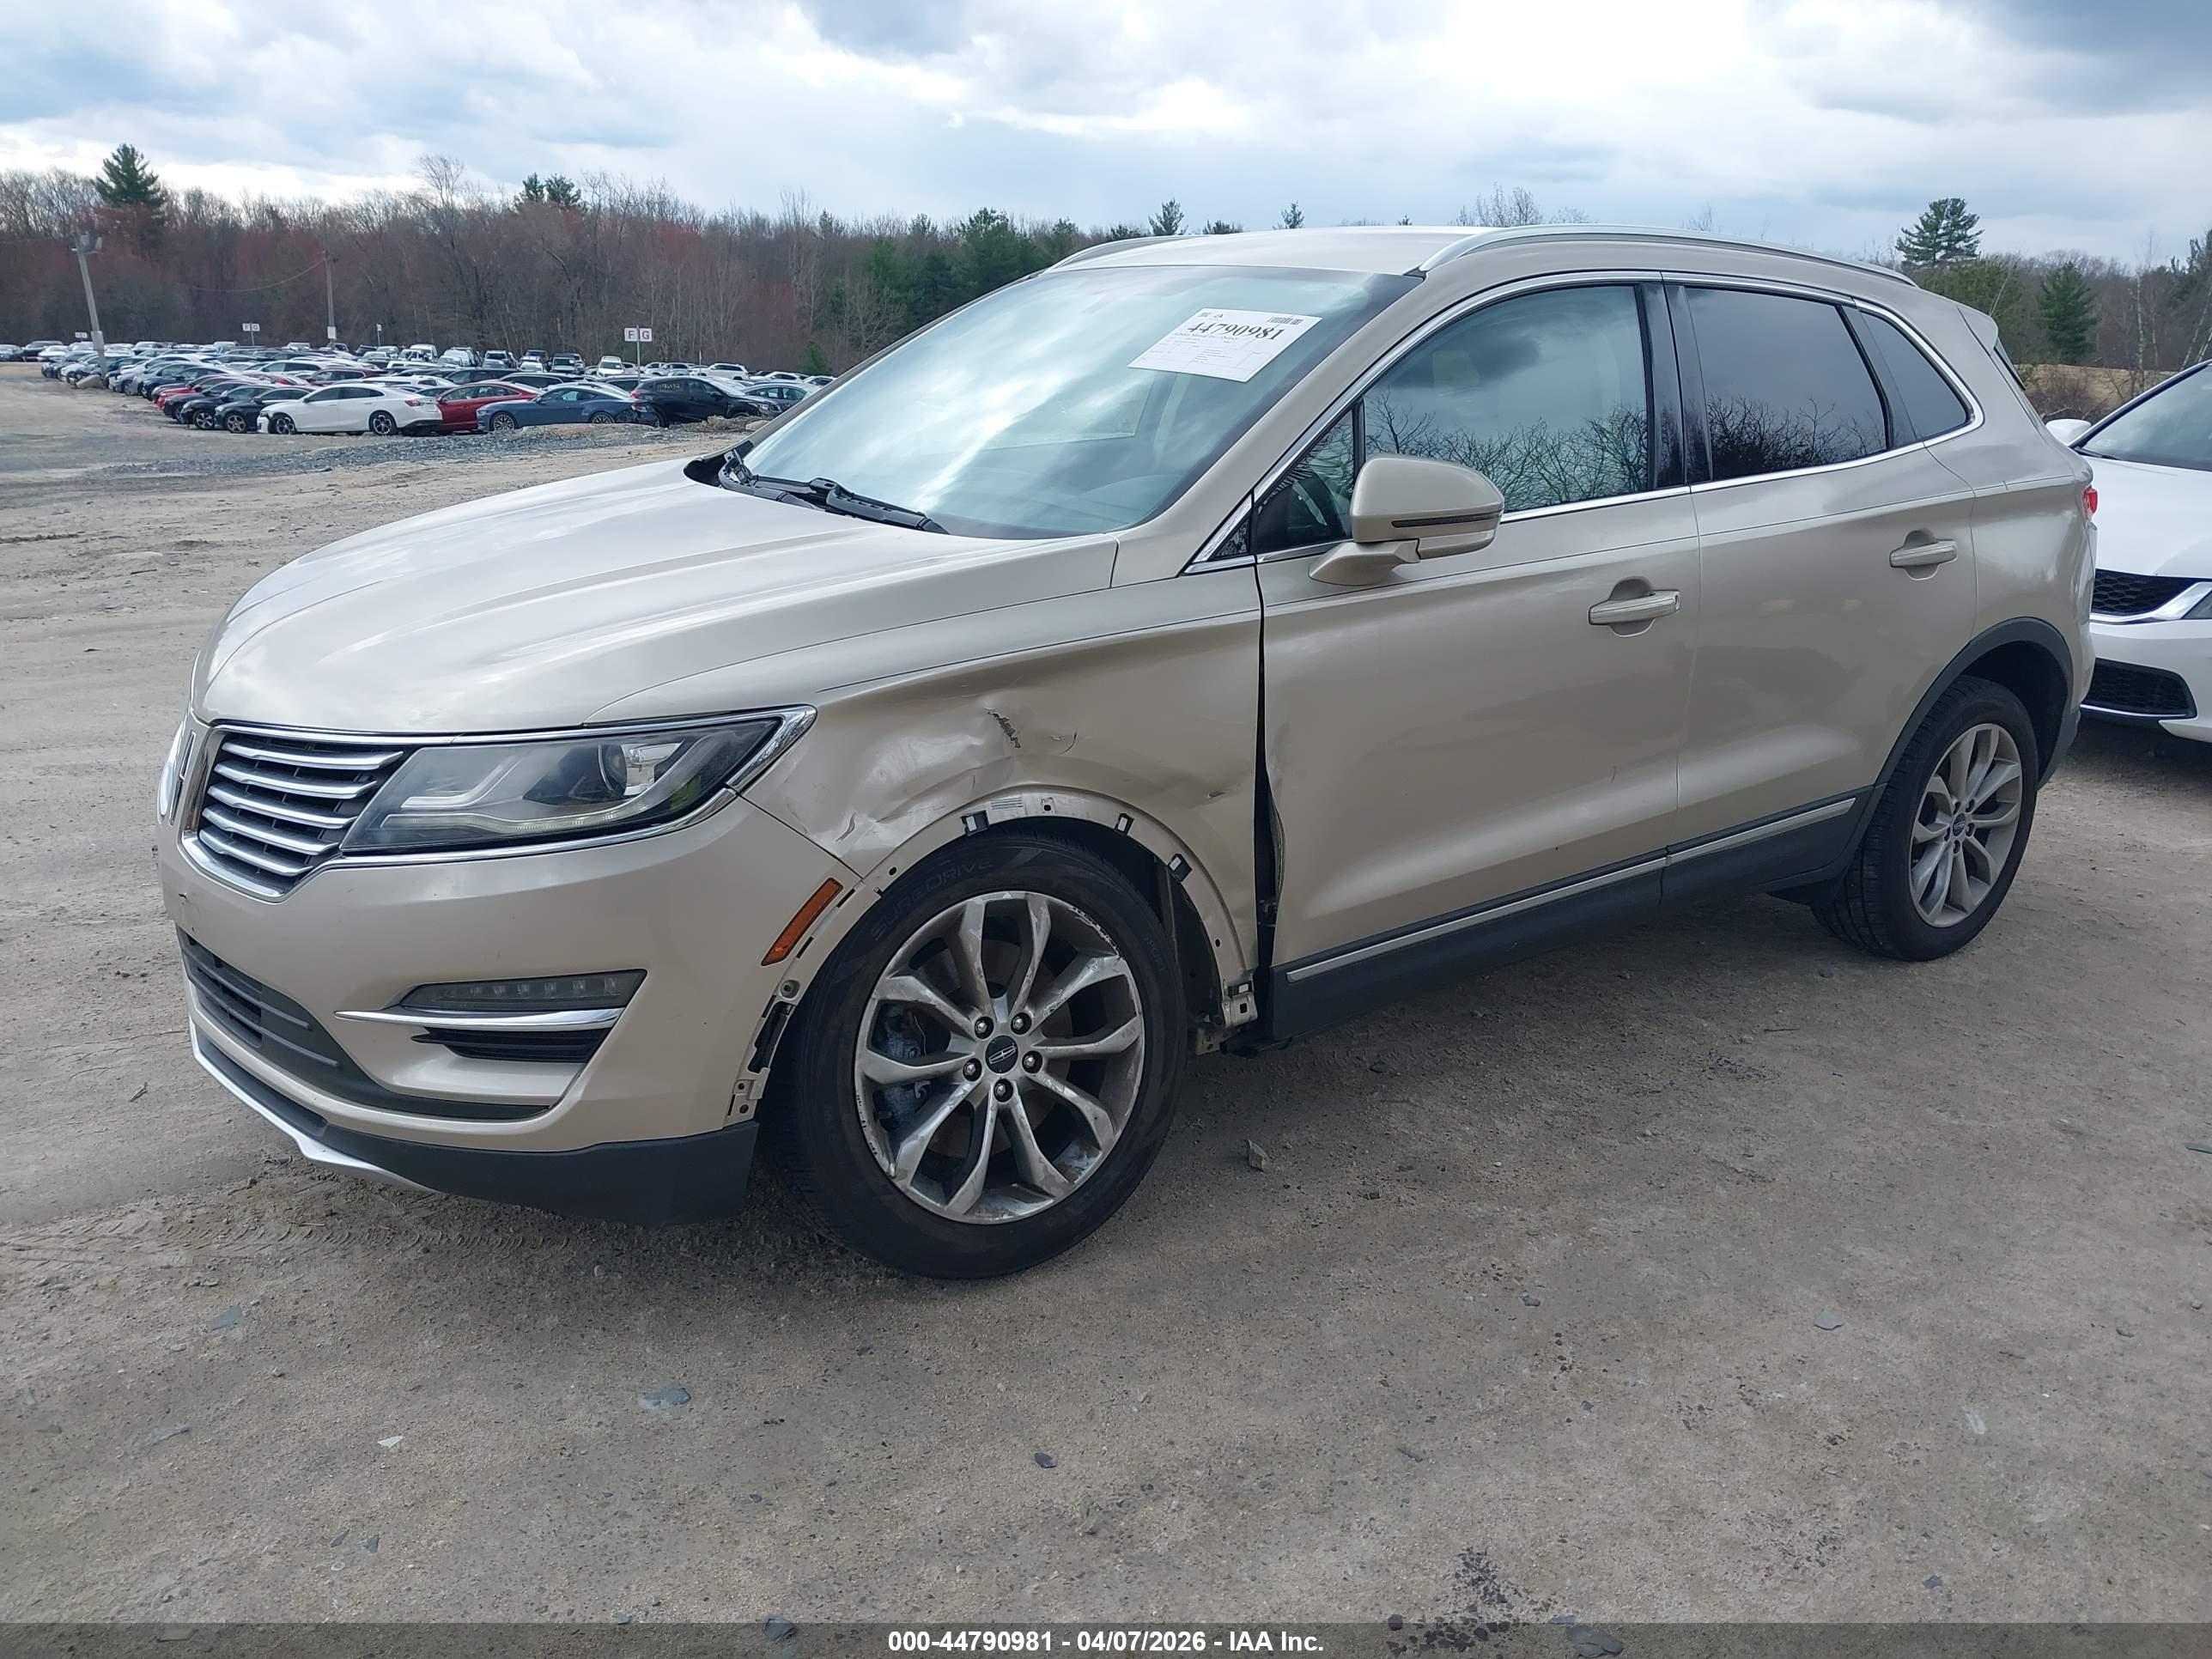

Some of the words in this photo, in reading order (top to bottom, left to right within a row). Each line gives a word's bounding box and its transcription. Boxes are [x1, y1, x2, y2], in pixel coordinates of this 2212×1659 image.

[628, 330, 635, 339] F
[641, 330, 650, 339] G
[1188, 322, 1285, 340] 44790981
